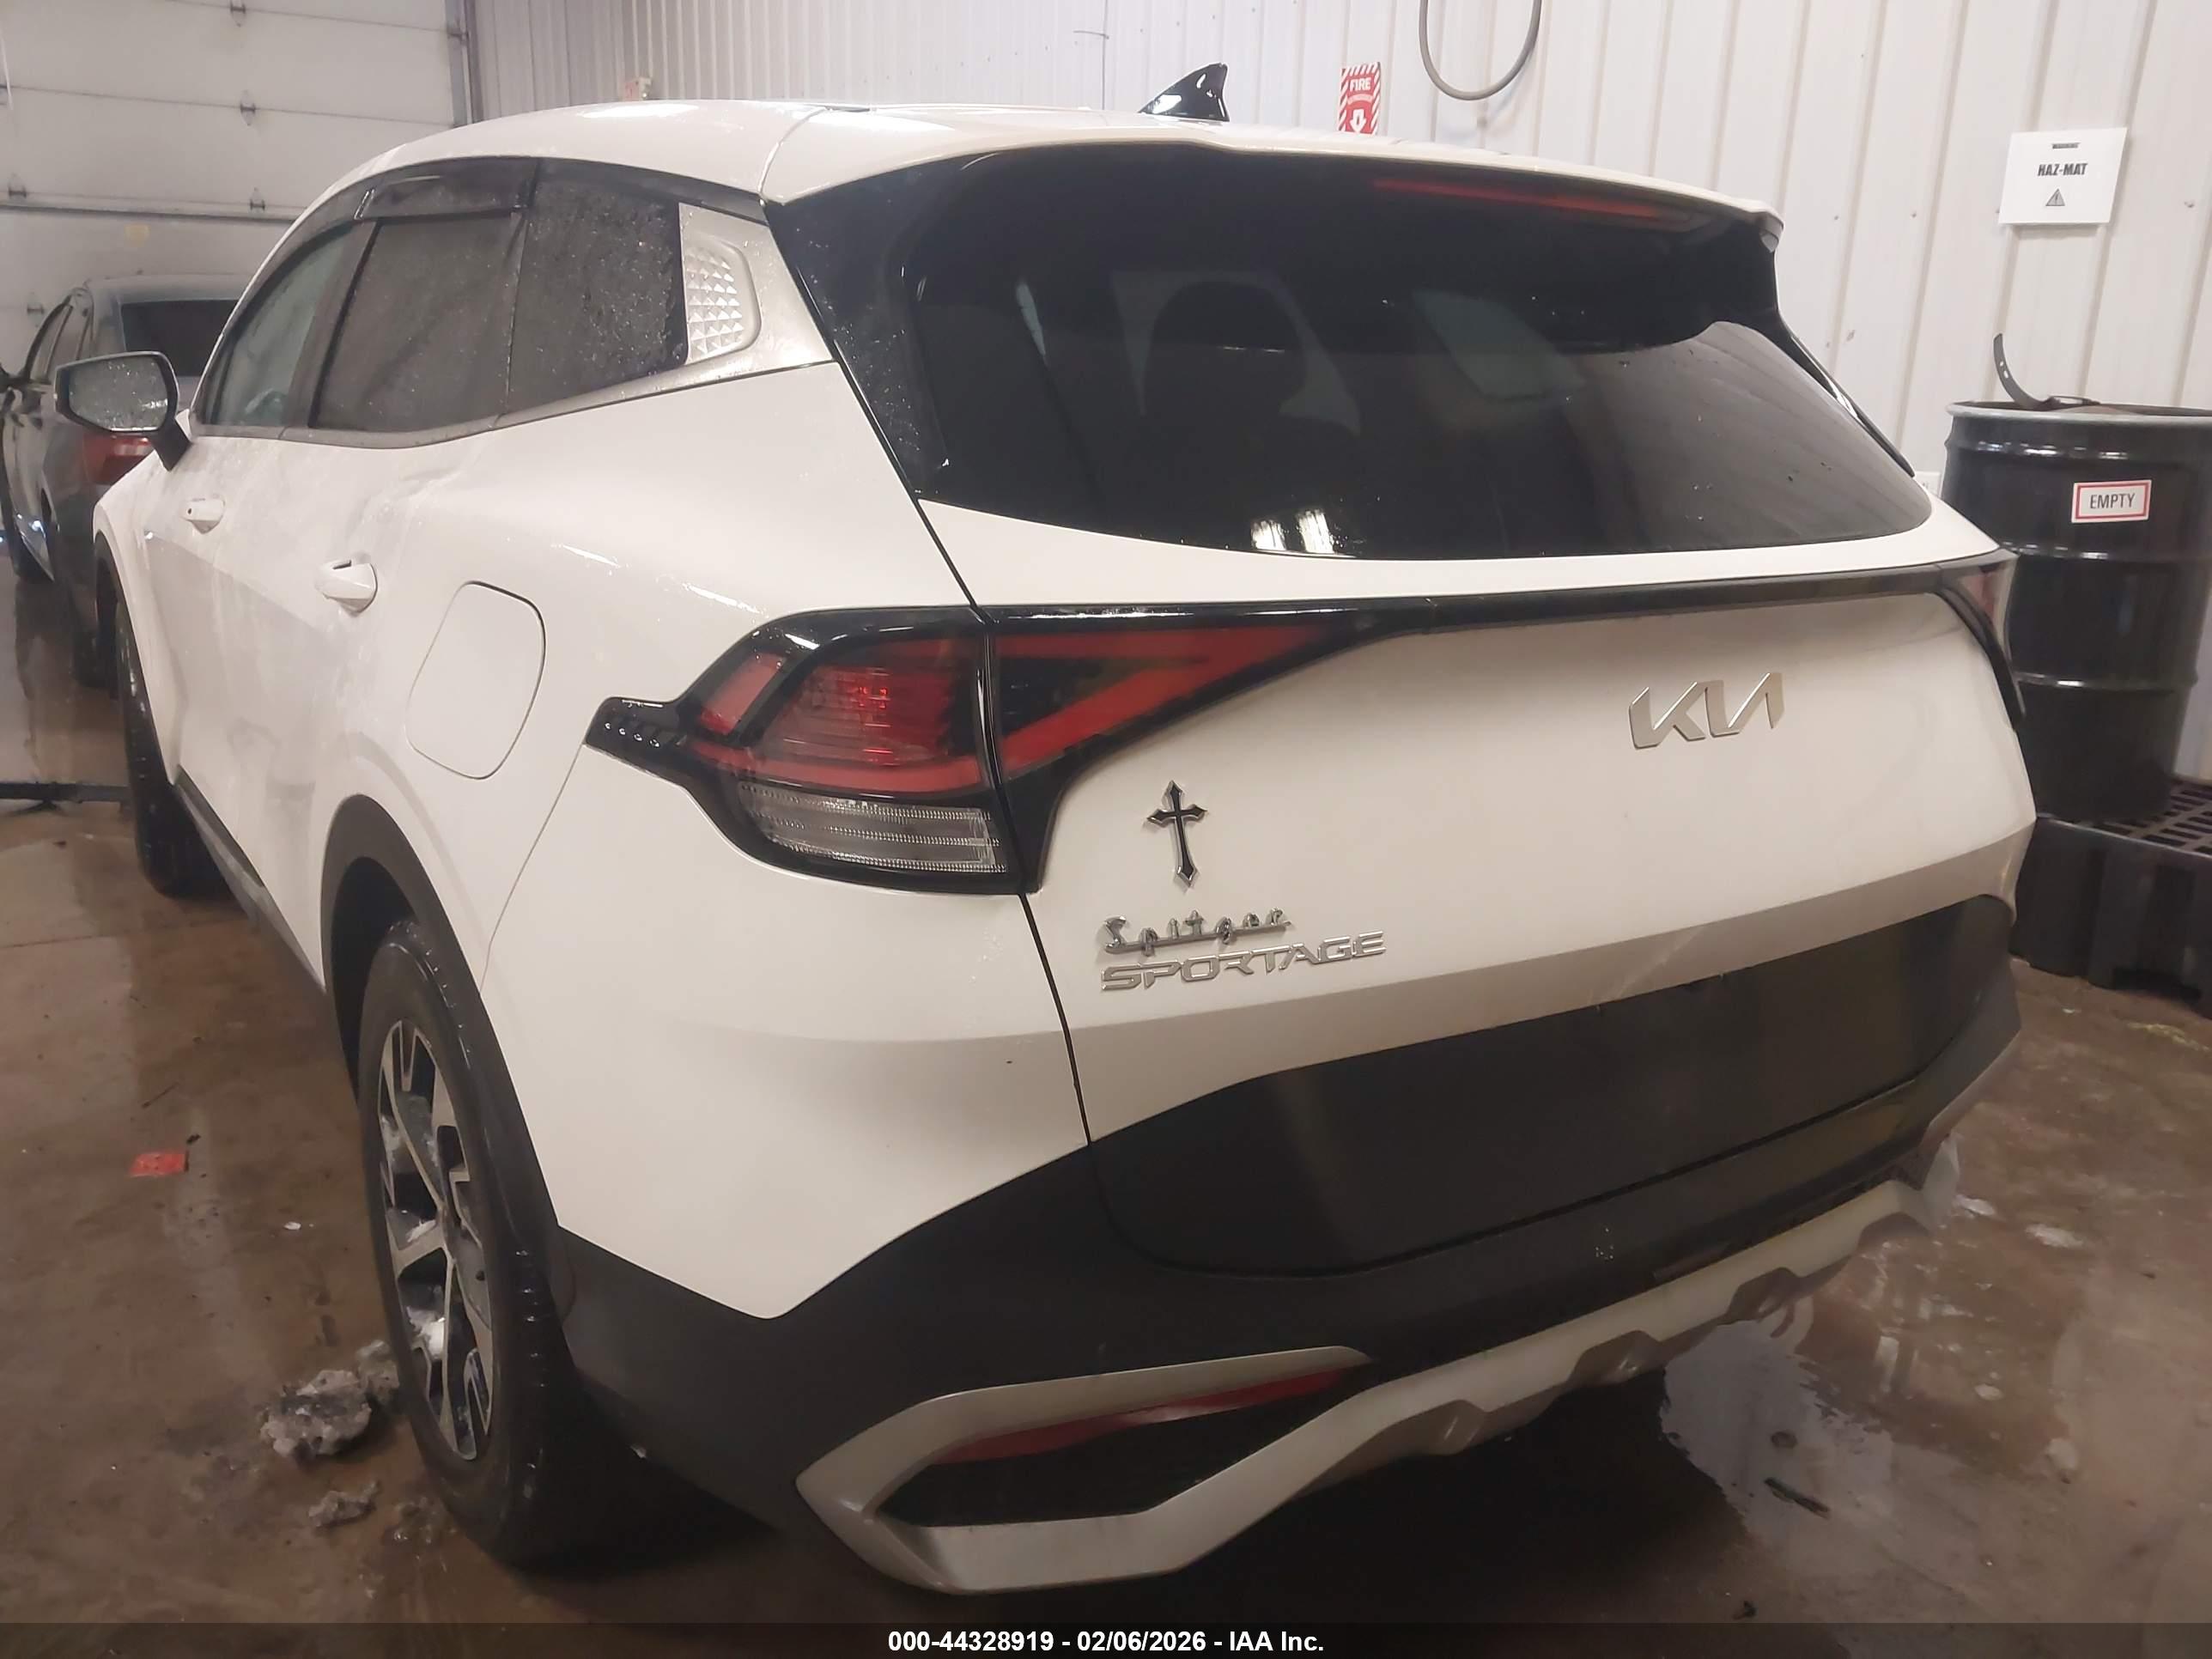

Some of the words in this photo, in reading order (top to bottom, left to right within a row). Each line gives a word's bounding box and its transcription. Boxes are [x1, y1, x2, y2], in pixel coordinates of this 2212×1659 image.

[1349, 77, 1372, 92] FIRE
[2038, 162, 2088, 177] HAZ-MAT
[2089, 493, 2136, 509] EMPTY
[1628, 672, 1785, 750] KIA
[1101, 930, 1387, 990] SPORTAGE
